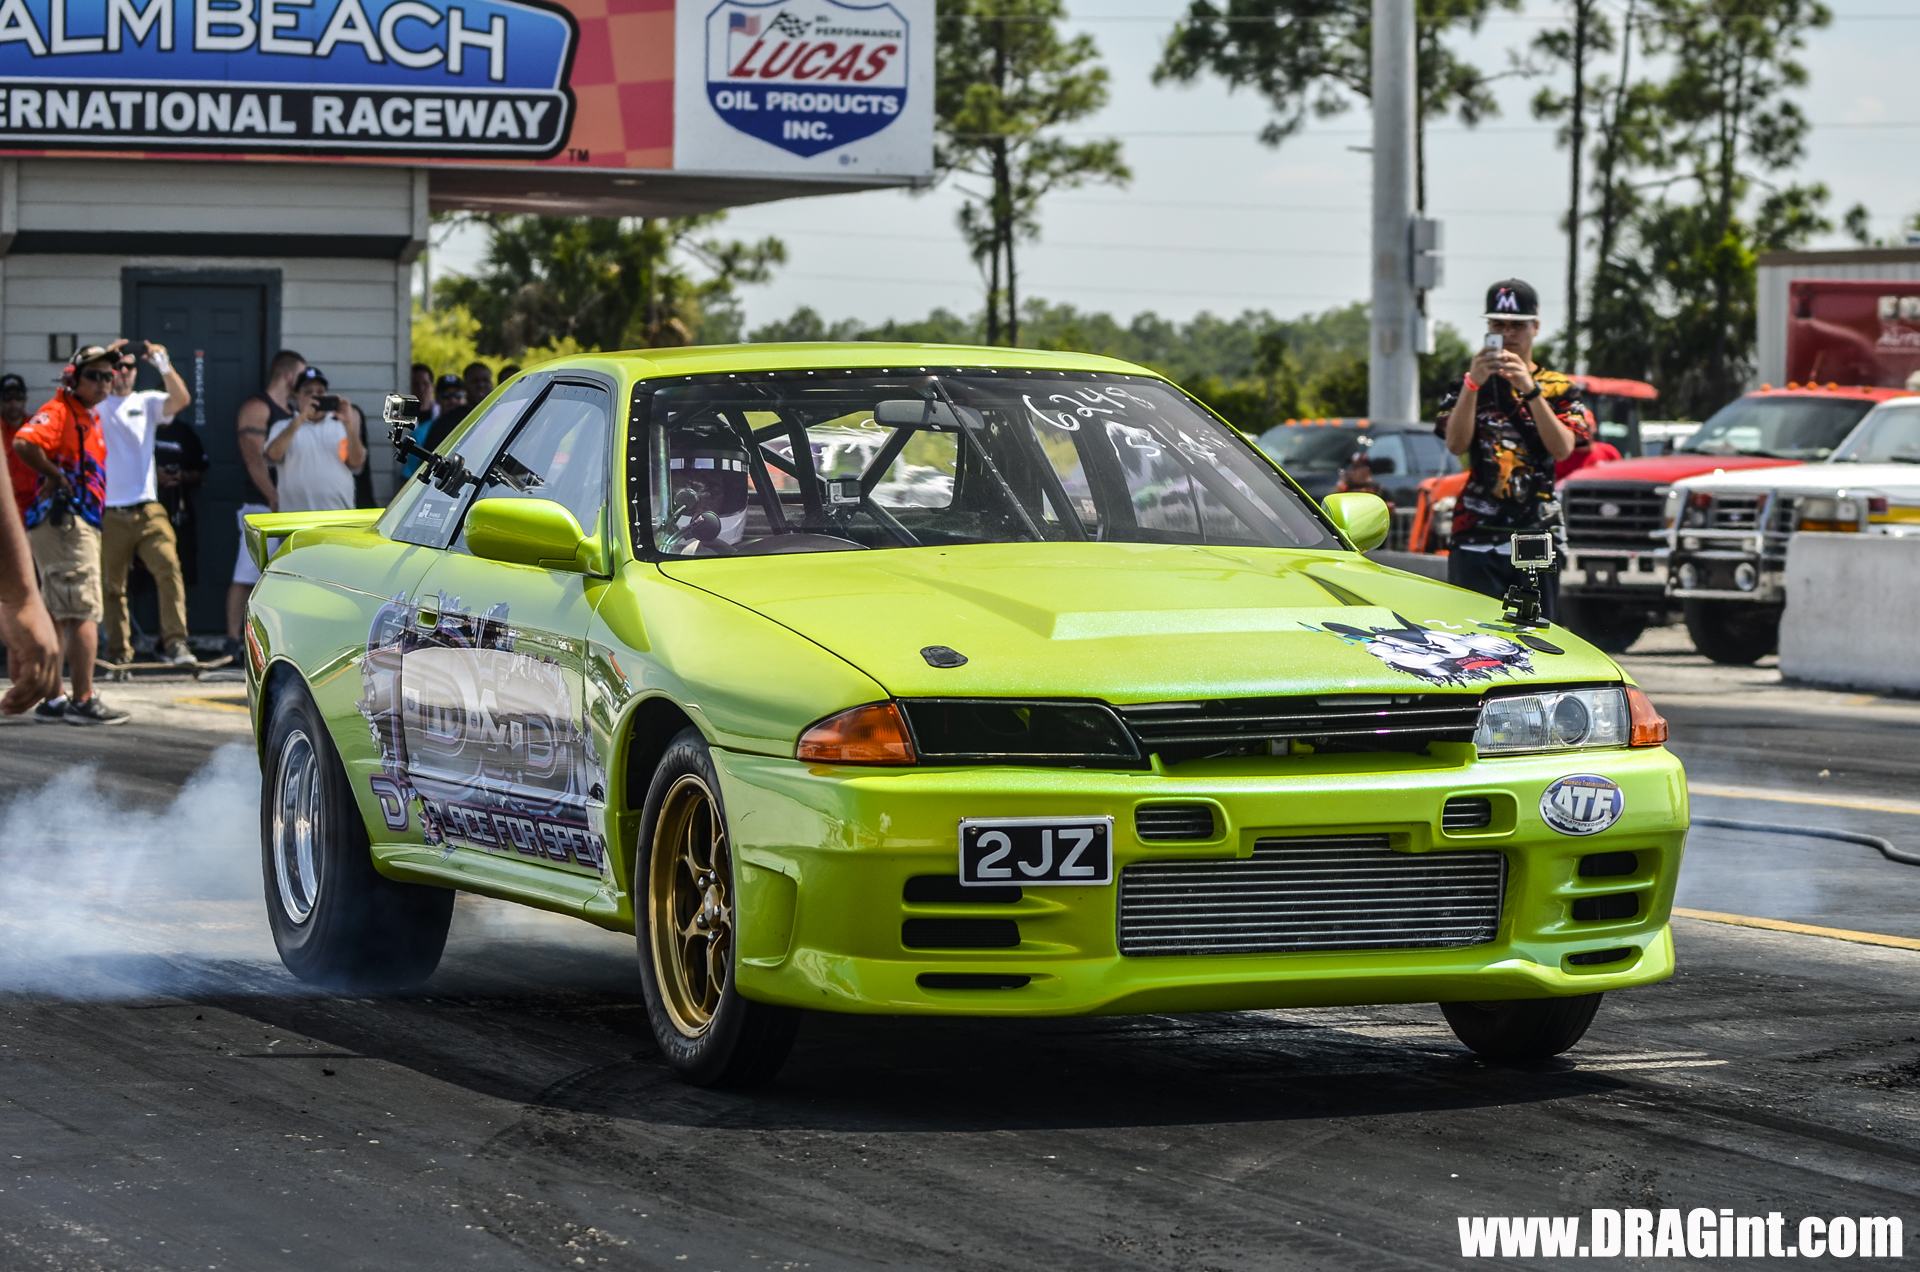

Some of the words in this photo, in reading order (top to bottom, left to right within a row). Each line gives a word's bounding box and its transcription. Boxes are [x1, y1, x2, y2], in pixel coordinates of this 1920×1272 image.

[193, 0, 506, 81] BEACH
[815, 27, 902, 38] PERFORMANCE
[729, 40, 898, 81] LUCAS
[313, 96, 550, 139] RACEWAY
[716, 91, 758, 110] OIL
[766, 92, 899, 114] PRODUCTS
[783, 120, 834, 140] INC.
[1554, 785, 1615, 820] ATF
[491, 812, 543, 852] FOR
[976, 828, 1095, 878] 2JZ
